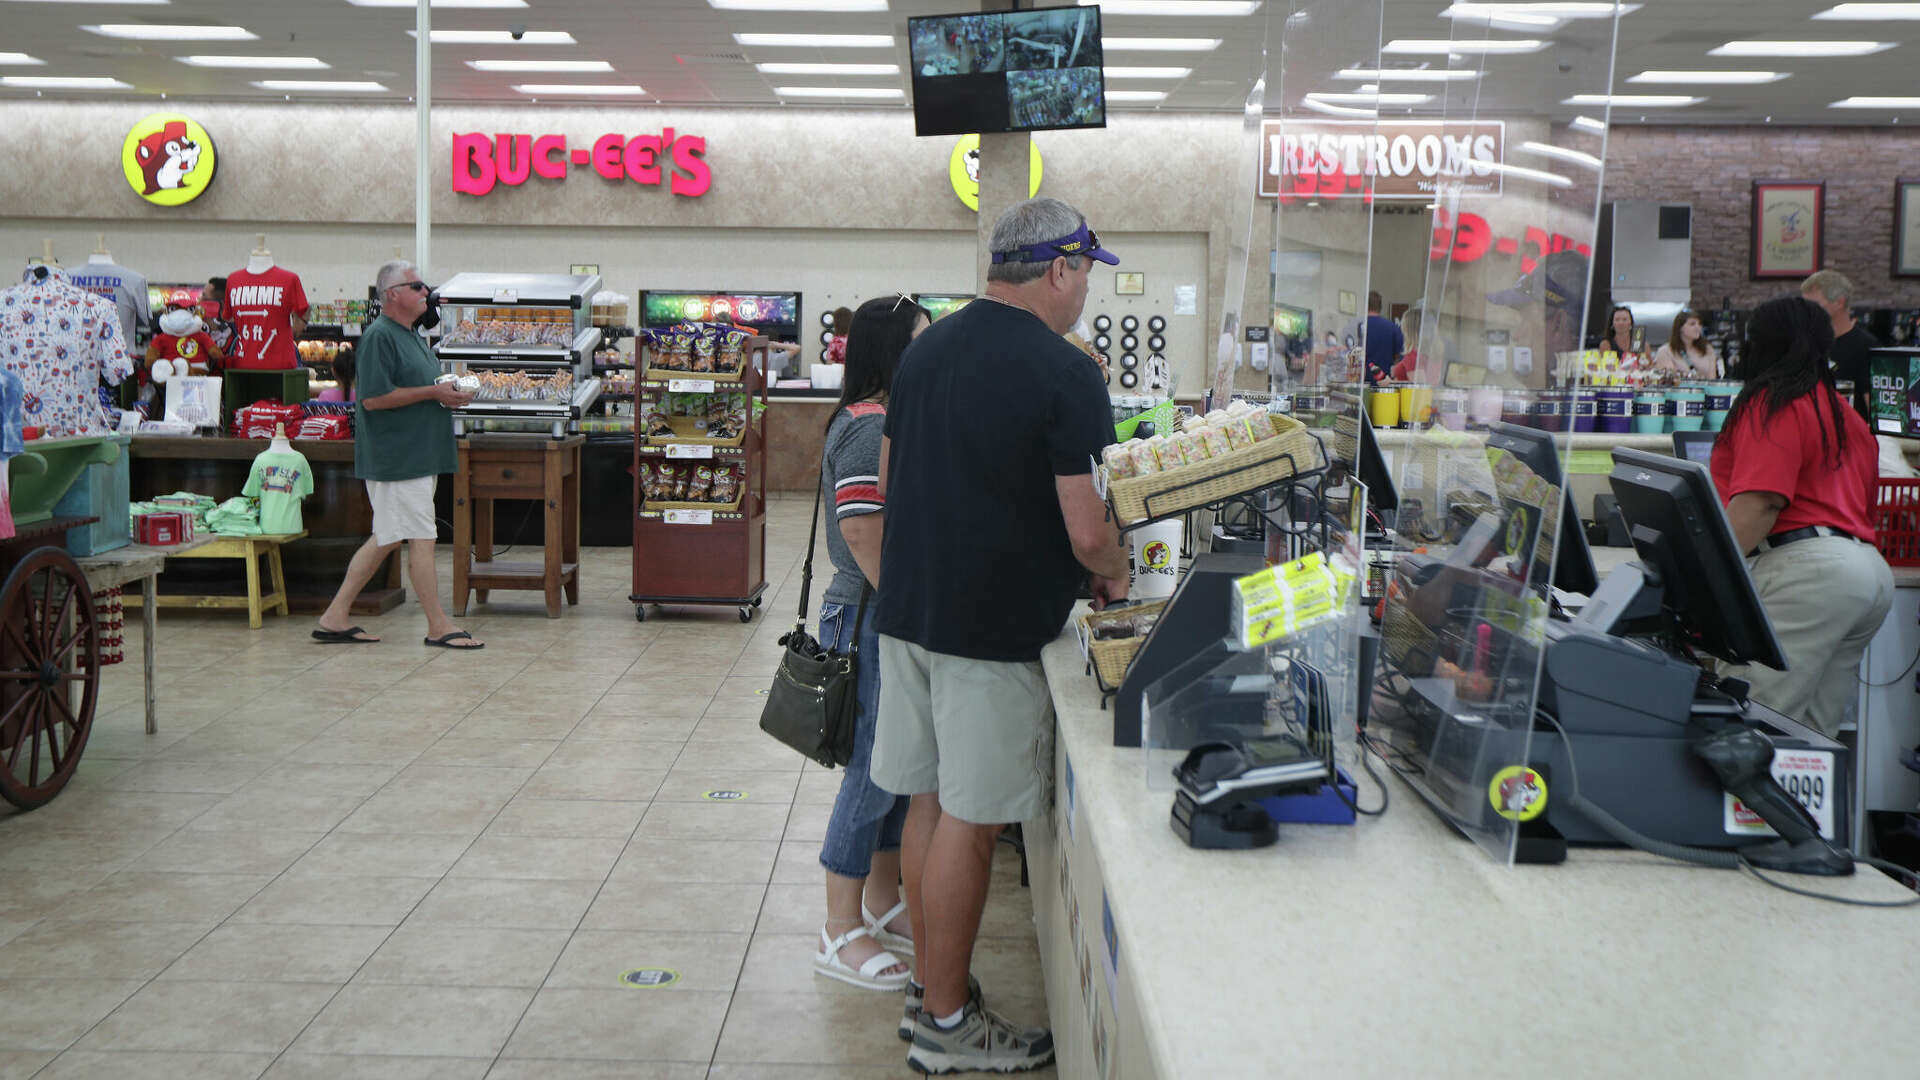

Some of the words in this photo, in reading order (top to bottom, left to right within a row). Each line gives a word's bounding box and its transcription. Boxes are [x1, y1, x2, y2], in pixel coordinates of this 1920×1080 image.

[452, 128, 711, 196] BUC-EE'S
[1268, 134, 1496, 177] RESTROOMS
[242, 324, 250, 340] 6
[253, 324, 263, 341] ft
[1872, 376, 1905, 390] BOLD
[1879, 391, 1898, 405] ICE
[1139, 565, 1175, 576] BUC-EE'S
